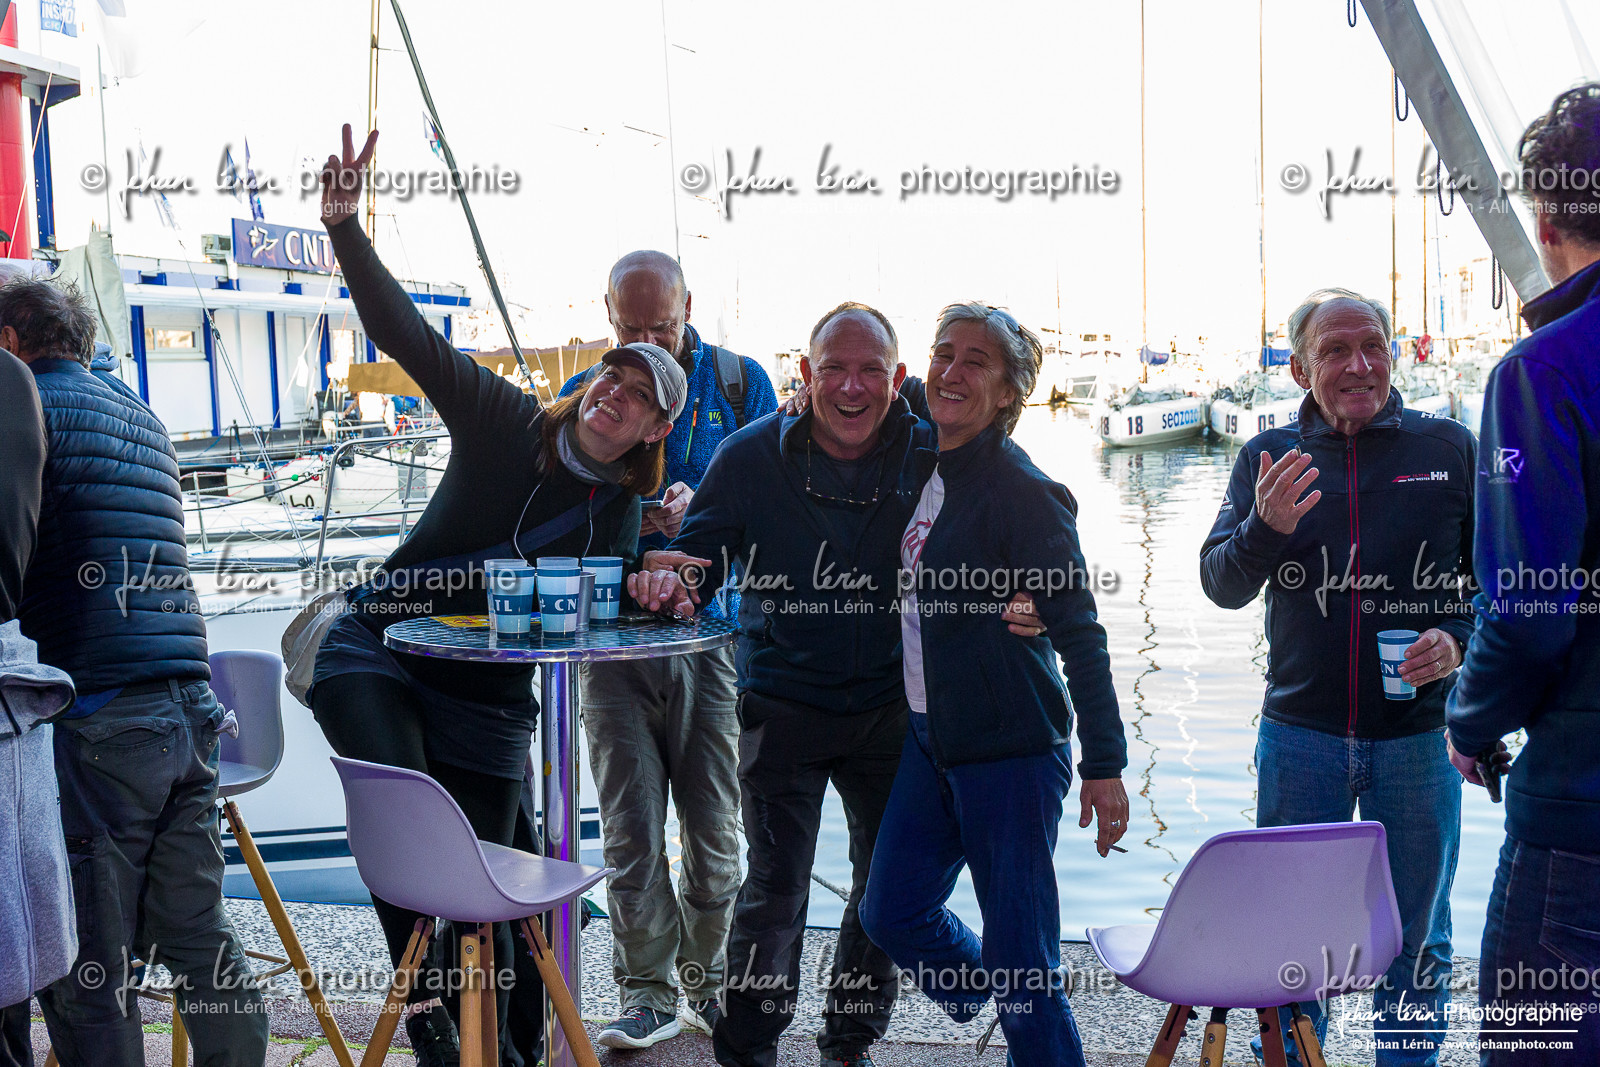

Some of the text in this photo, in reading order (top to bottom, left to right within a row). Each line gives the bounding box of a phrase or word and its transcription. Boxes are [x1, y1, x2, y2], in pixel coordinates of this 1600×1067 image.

[284, 230, 341, 269] CNT
[1128, 416, 1143, 436] 18
[1226, 414, 1238, 434] 09
[1430, 471, 1448, 480] HH
[594, 588, 614, 598] TL
[494, 600, 512, 612] TL
[554, 598, 577, 612] CN
